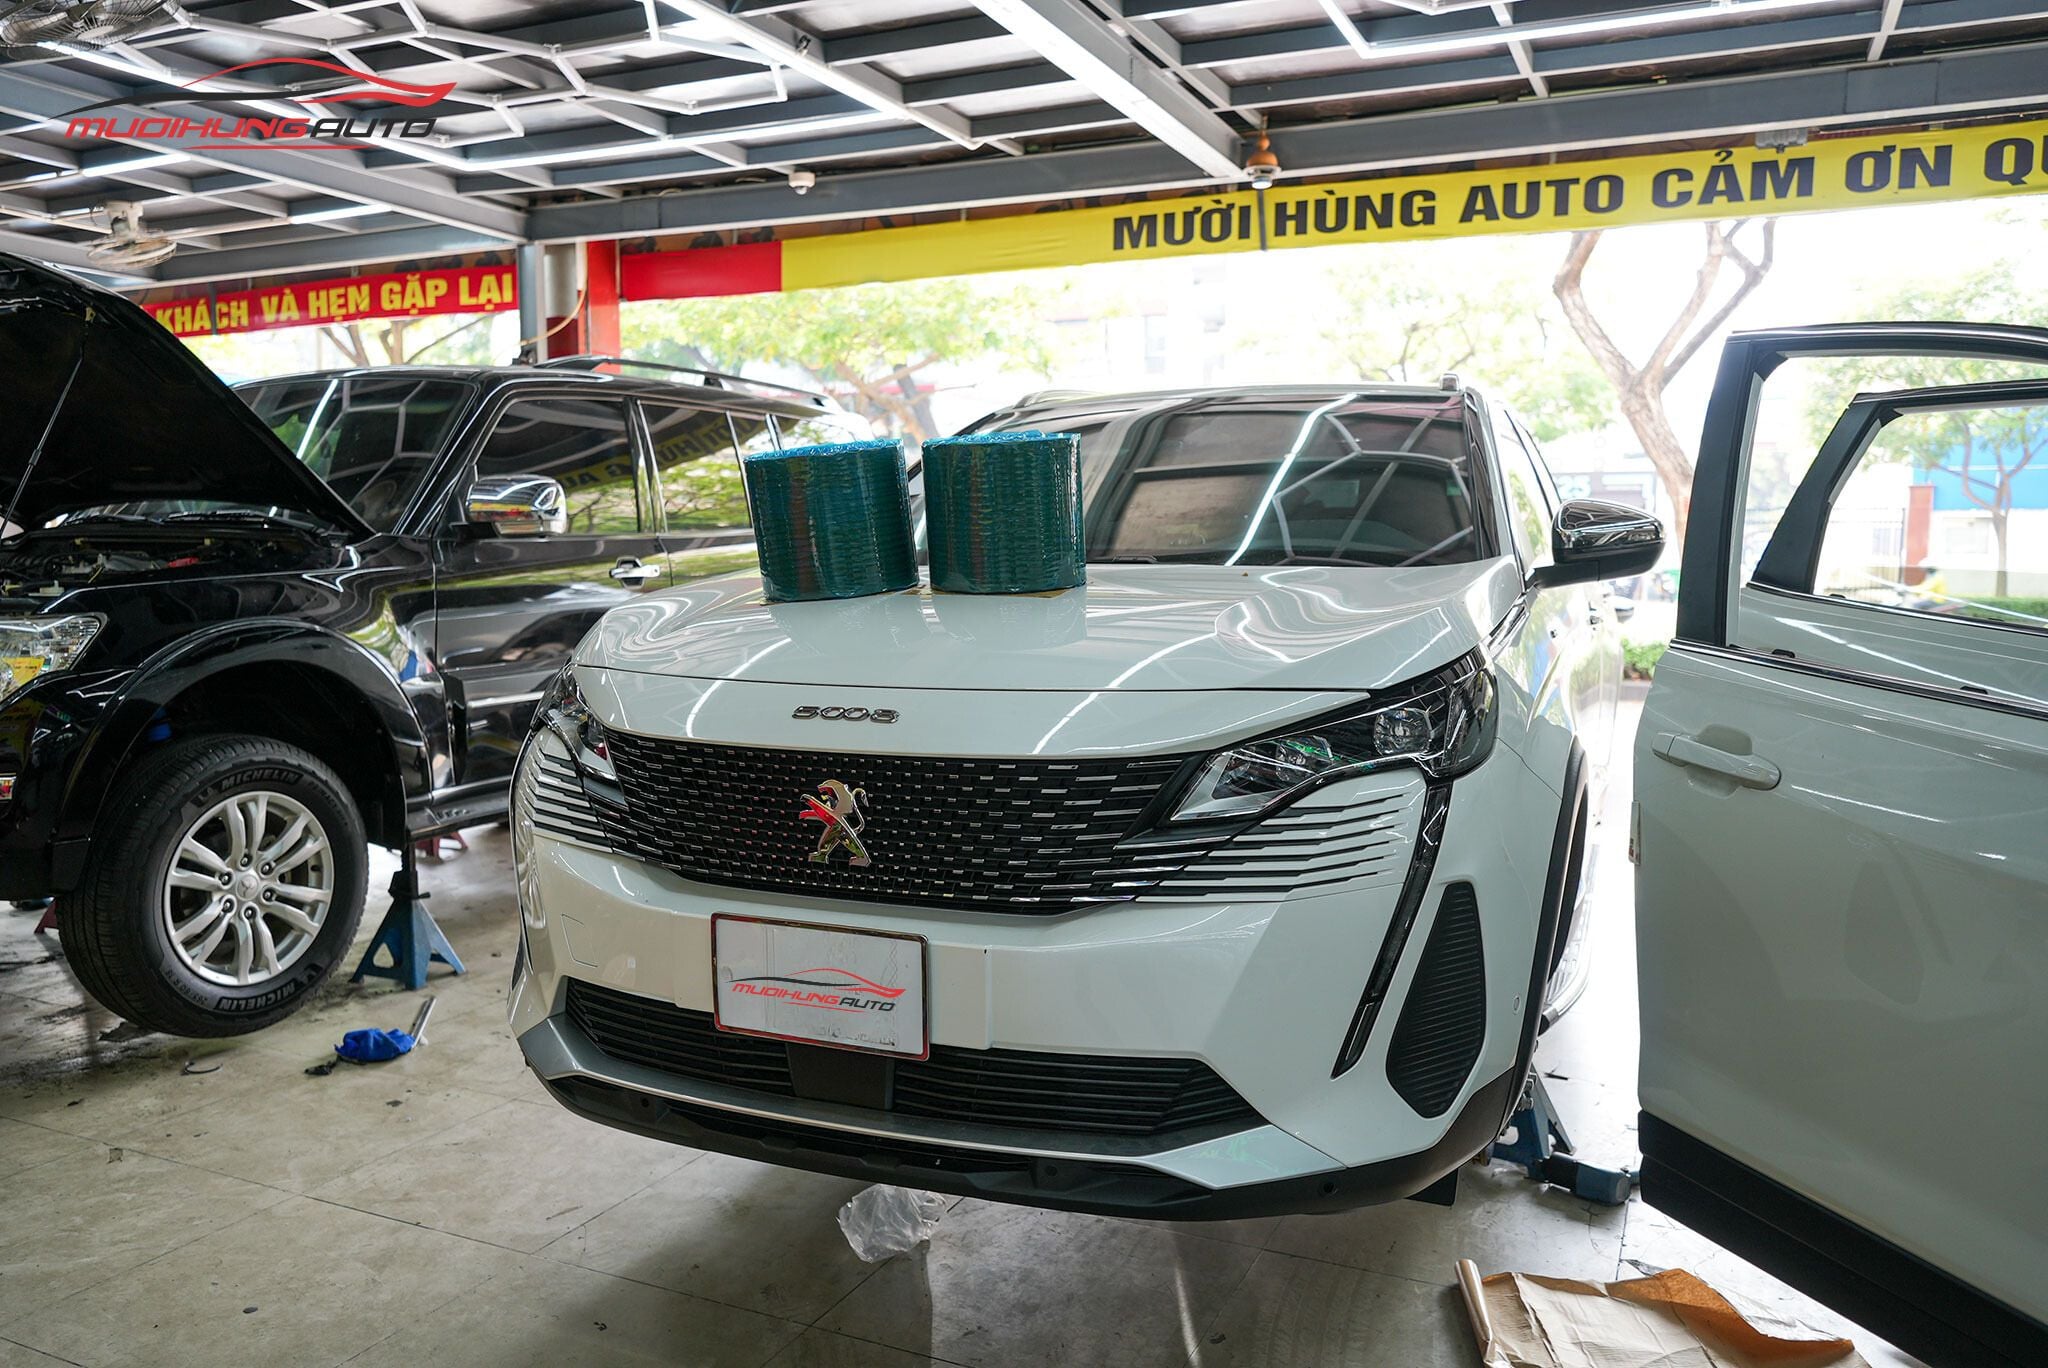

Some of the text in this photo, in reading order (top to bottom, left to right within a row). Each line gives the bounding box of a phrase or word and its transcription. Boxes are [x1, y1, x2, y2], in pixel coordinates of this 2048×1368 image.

[1113, 135, 2048, 251] MƯỜI HÙNG AUTO CẢM ƠN Q
[156, 272, 513, 333] KHÁCH VÀ HẸN GẶP LẠI
[792, 705, 900, 724] 5008
[221, 768, 300, 791] MICHELIN
[219, 981, 296, 1010] MICHELIN
